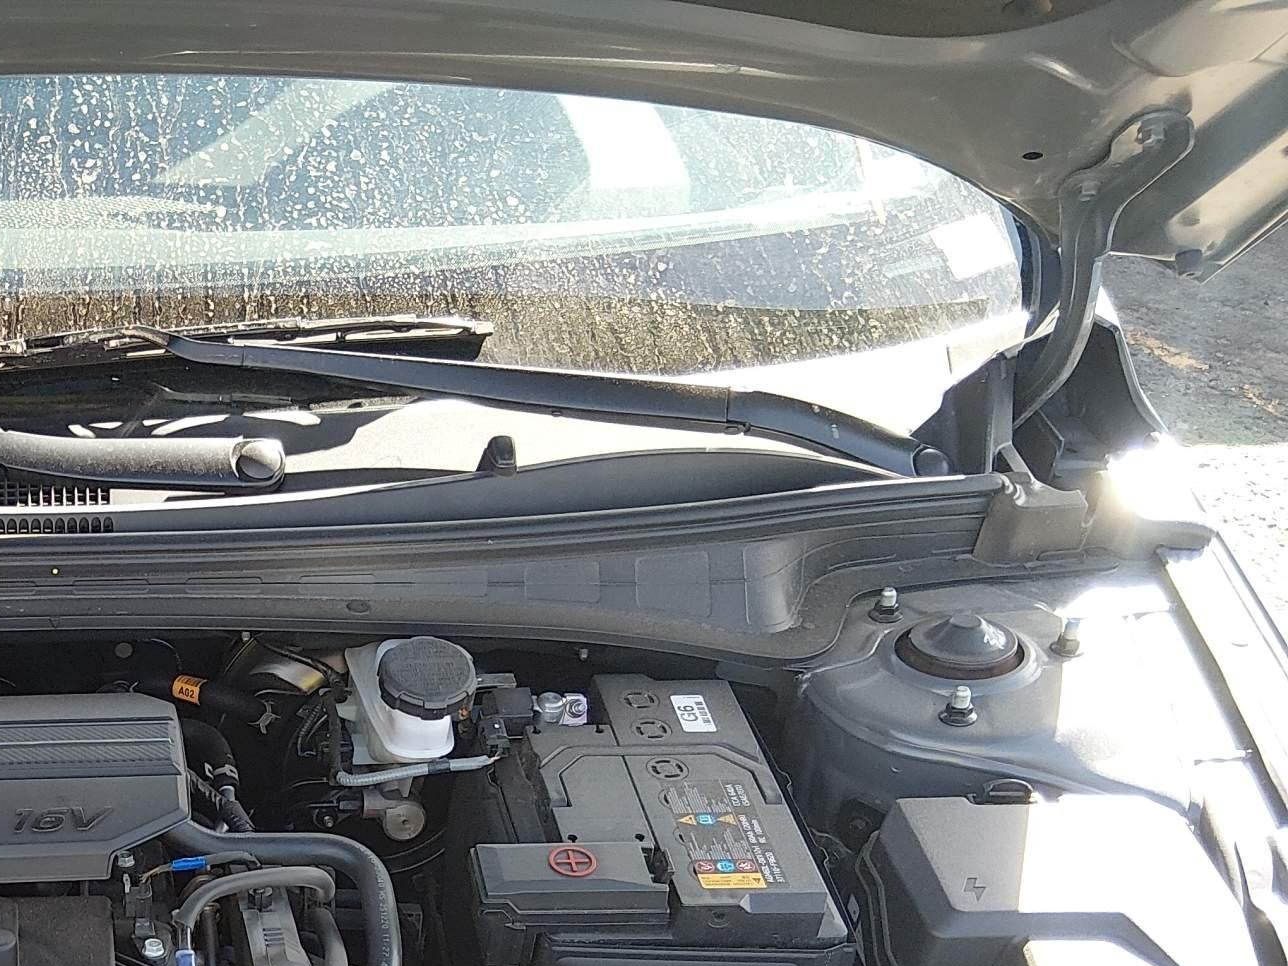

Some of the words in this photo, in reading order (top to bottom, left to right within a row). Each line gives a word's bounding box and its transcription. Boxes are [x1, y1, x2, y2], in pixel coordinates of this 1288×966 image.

[178, 686, 195, 699] A02
[677, 705, 699, 722] G6
[13, 806, 113, 834] 16V
